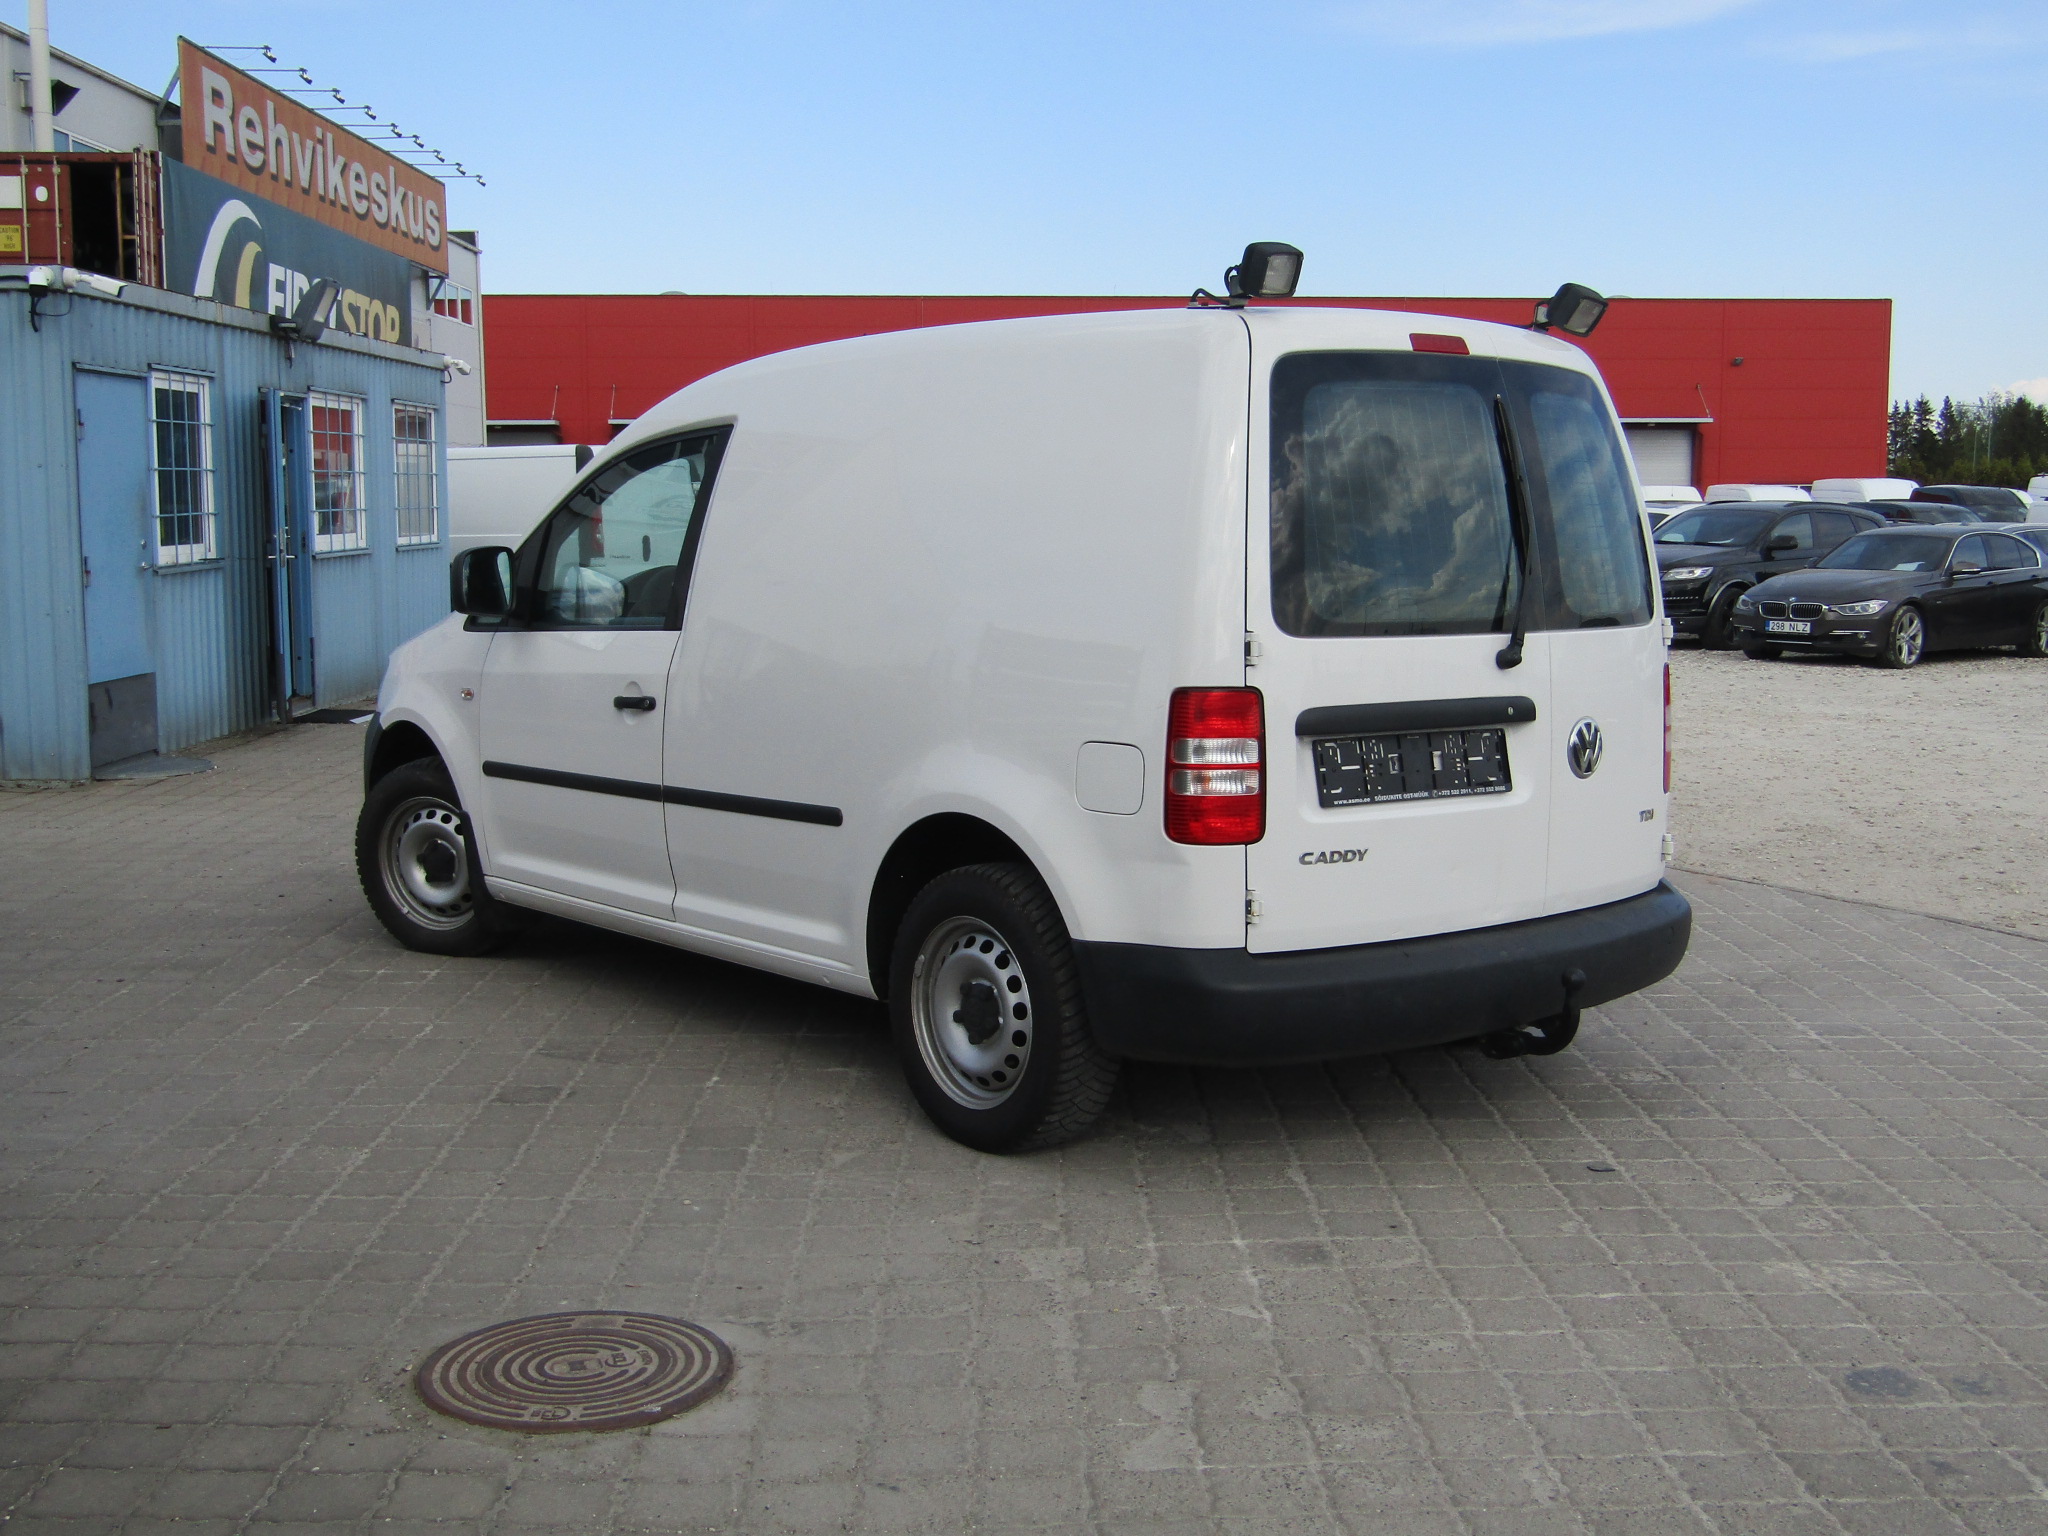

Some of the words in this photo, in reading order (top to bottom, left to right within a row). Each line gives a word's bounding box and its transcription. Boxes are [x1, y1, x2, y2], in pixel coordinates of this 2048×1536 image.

[202, 65, 442, 248] Rehvikeskus
[1771, 622, 1785, 631] 298
[1789, 623, 1808, 632] NLZ
[1299, 848, 1368, 866] CADDY
